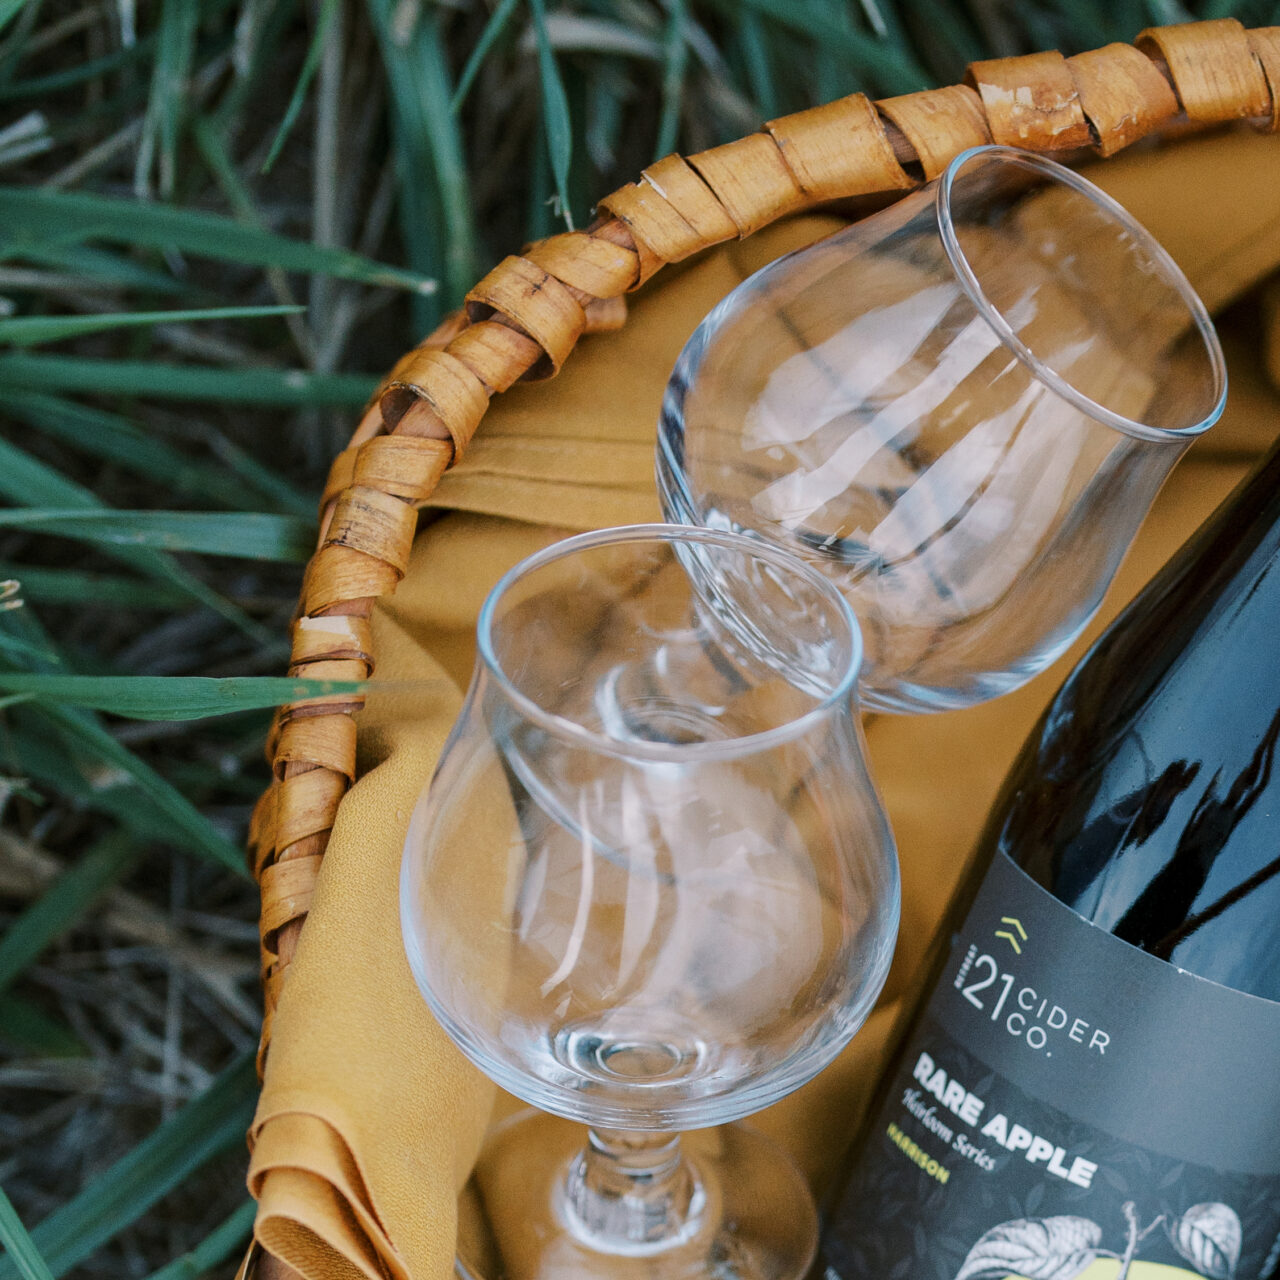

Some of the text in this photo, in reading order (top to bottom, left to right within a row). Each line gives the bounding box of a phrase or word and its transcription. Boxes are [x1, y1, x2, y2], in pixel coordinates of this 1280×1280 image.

[962, 954, 1015, 1021] 21
[1018, 987, 1110, 1054] CIDER
[1006, 1012, 1052, 1058] CO.
[913, 1051, 1098, 1189] RARE APPLE
[886, 1122, 950, 1184] HARRISON
[952, 1133, 996, 1171] Series
